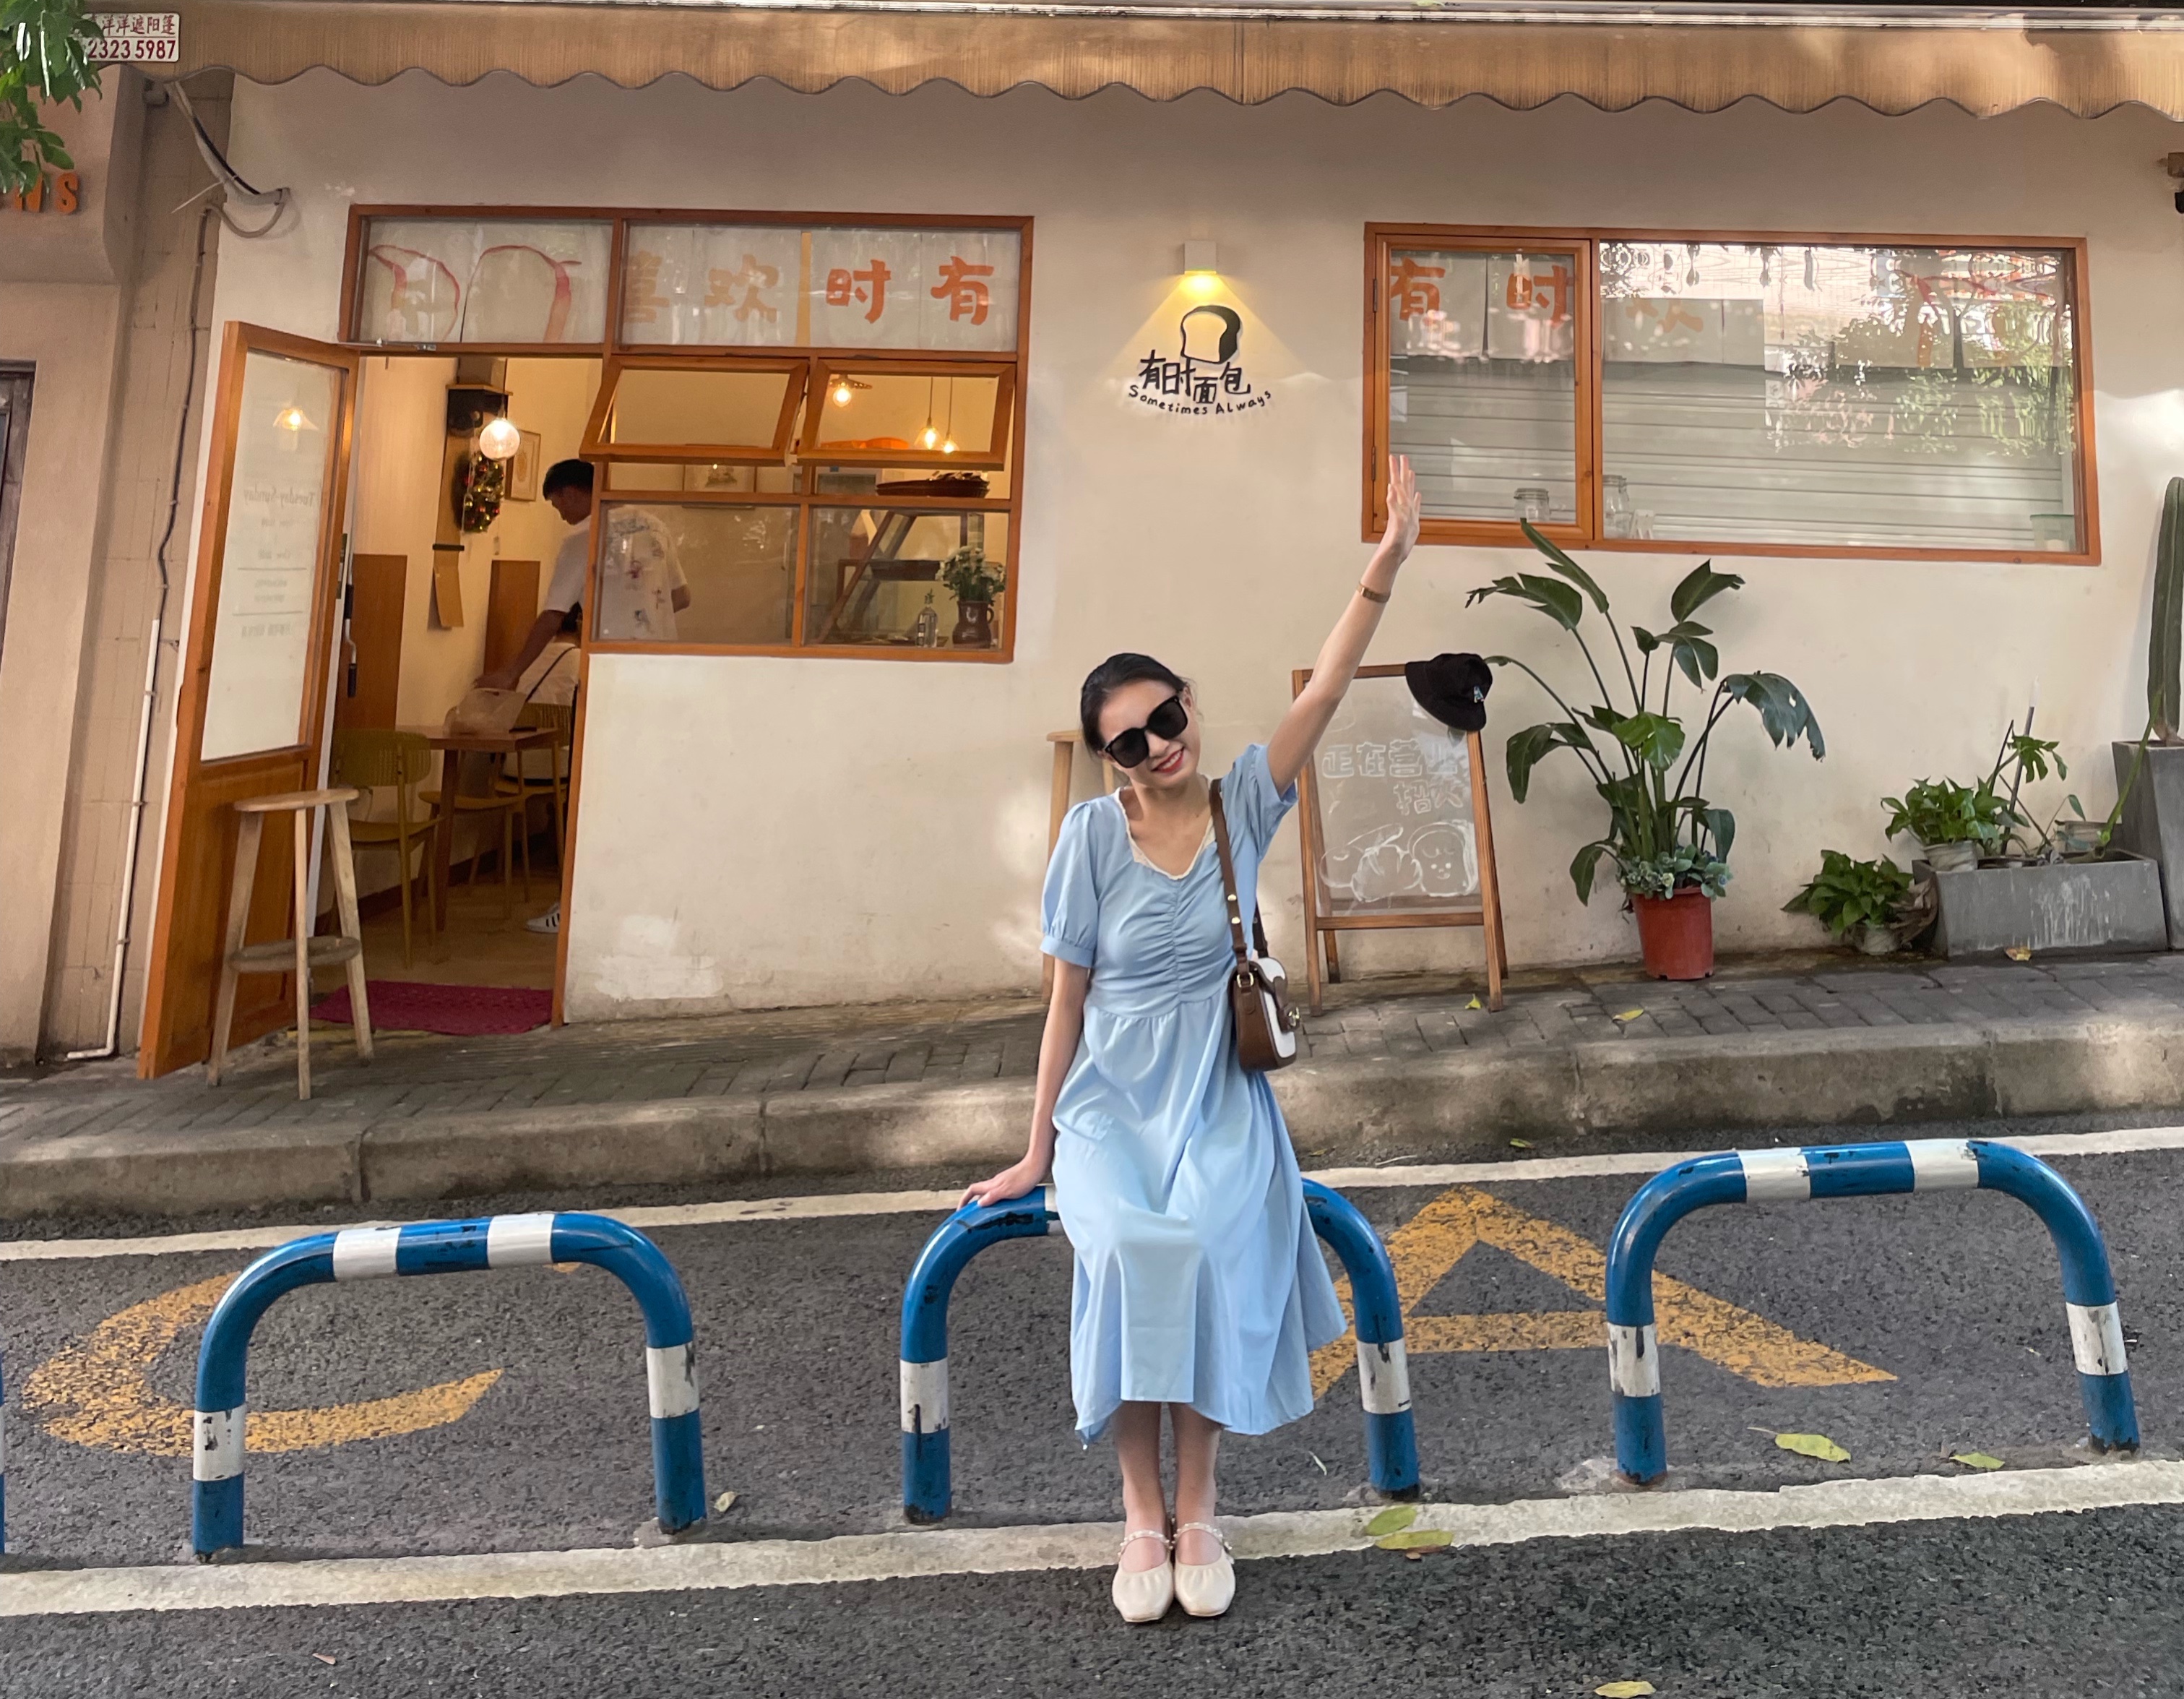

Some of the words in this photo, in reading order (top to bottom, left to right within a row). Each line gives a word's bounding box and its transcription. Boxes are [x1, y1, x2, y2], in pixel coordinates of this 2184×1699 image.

[92, 14, 176, 36] 洋洋遮阳篷
[1139, 350, 1251, 405] 有时面包
[1128, 384, 1208, 415] Sometimes
